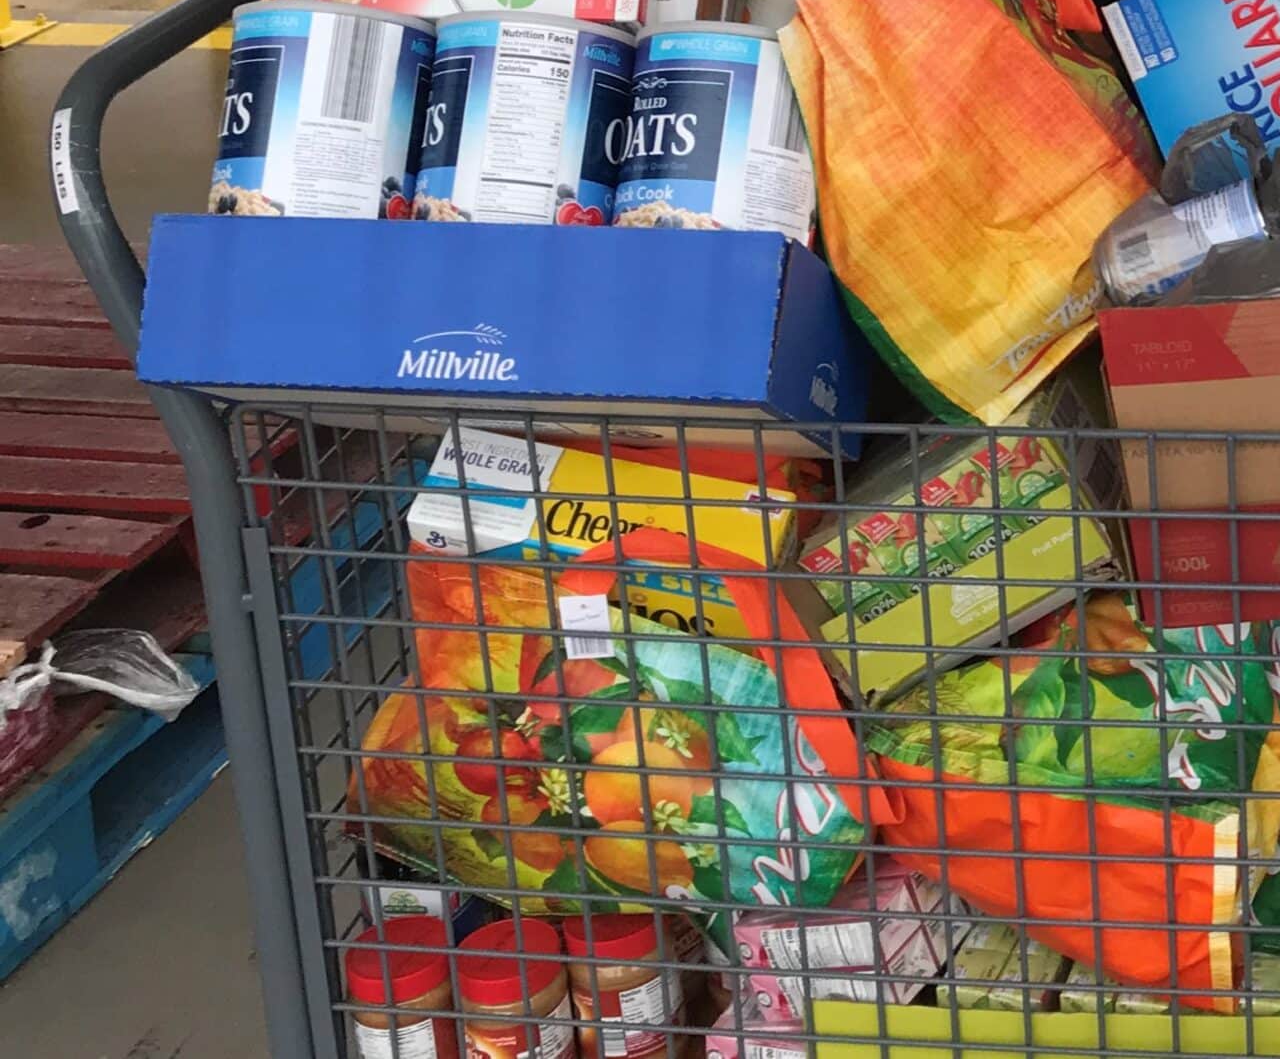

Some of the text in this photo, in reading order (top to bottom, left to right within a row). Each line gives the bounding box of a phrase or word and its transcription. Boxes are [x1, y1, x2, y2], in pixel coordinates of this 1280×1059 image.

[502, 29, 574, 45] Nutrition Facts
[496, 64, 569, 78] Calories 150
[218, 92, 253, 138] TS
[54, 122, 68, 199] 150 LBS
[636, 184, 675, 200] Cook
[1131, 340, 1193, 355] TABLOID
[397, 348, 516, 382] Millville
[443, 447, 545, 477] WHOLE GRAIN
[1050, 526, 1074, 544] Punc
[862, 597, 897, 622] 00%
